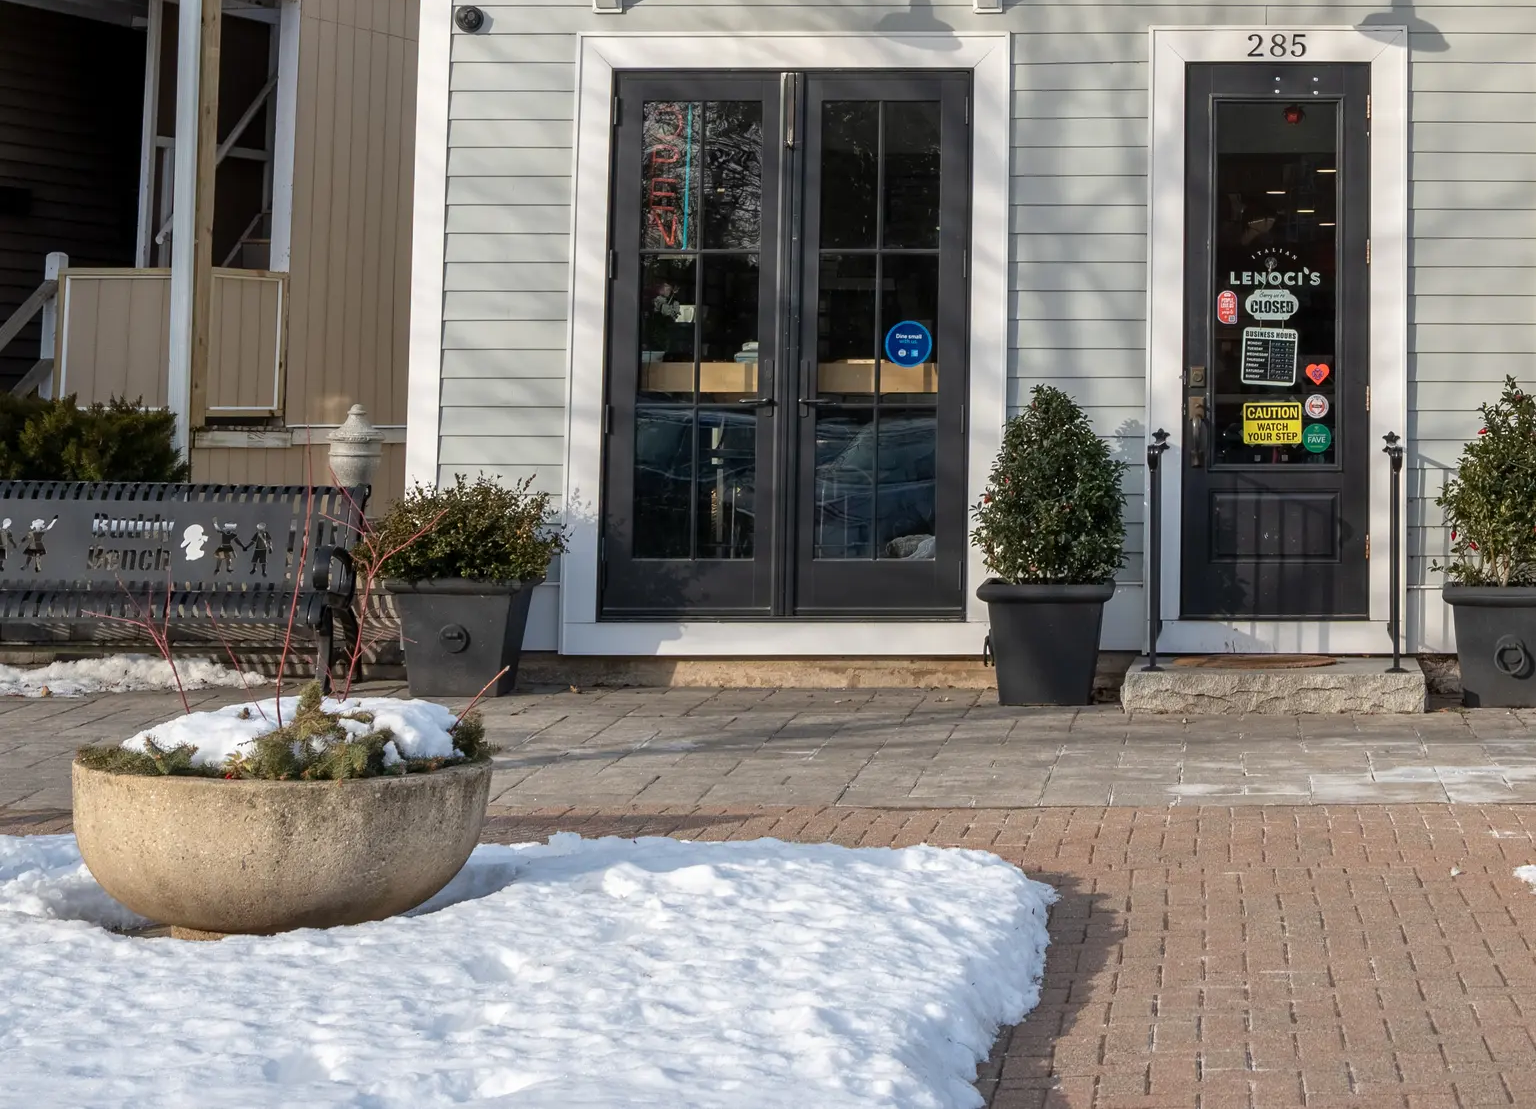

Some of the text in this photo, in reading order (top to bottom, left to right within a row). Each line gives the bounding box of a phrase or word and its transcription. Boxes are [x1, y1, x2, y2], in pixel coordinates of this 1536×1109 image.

[1247, 33, 1307, 58] 285
[1251, 247, 1298, 261] ITALIAN
[1230, 266, 1321, 286] LENOCI'S
[1250, 300, 1294, 314] CLOSED
[1245, 330, 1297, 340] BUSINESS HOURS
[1247, 406, 1298, 419] CAUTION
[1257, 422, 1289, 431] WATCH
[1248, 432, 1272, 441] YOUR
[1275, 432, 1298, 441] STEP
[1307, 436, 1326, 444] FAVE
[92, 512, 175, 542] Buddy
[87, 545, 171, 571] Bench
